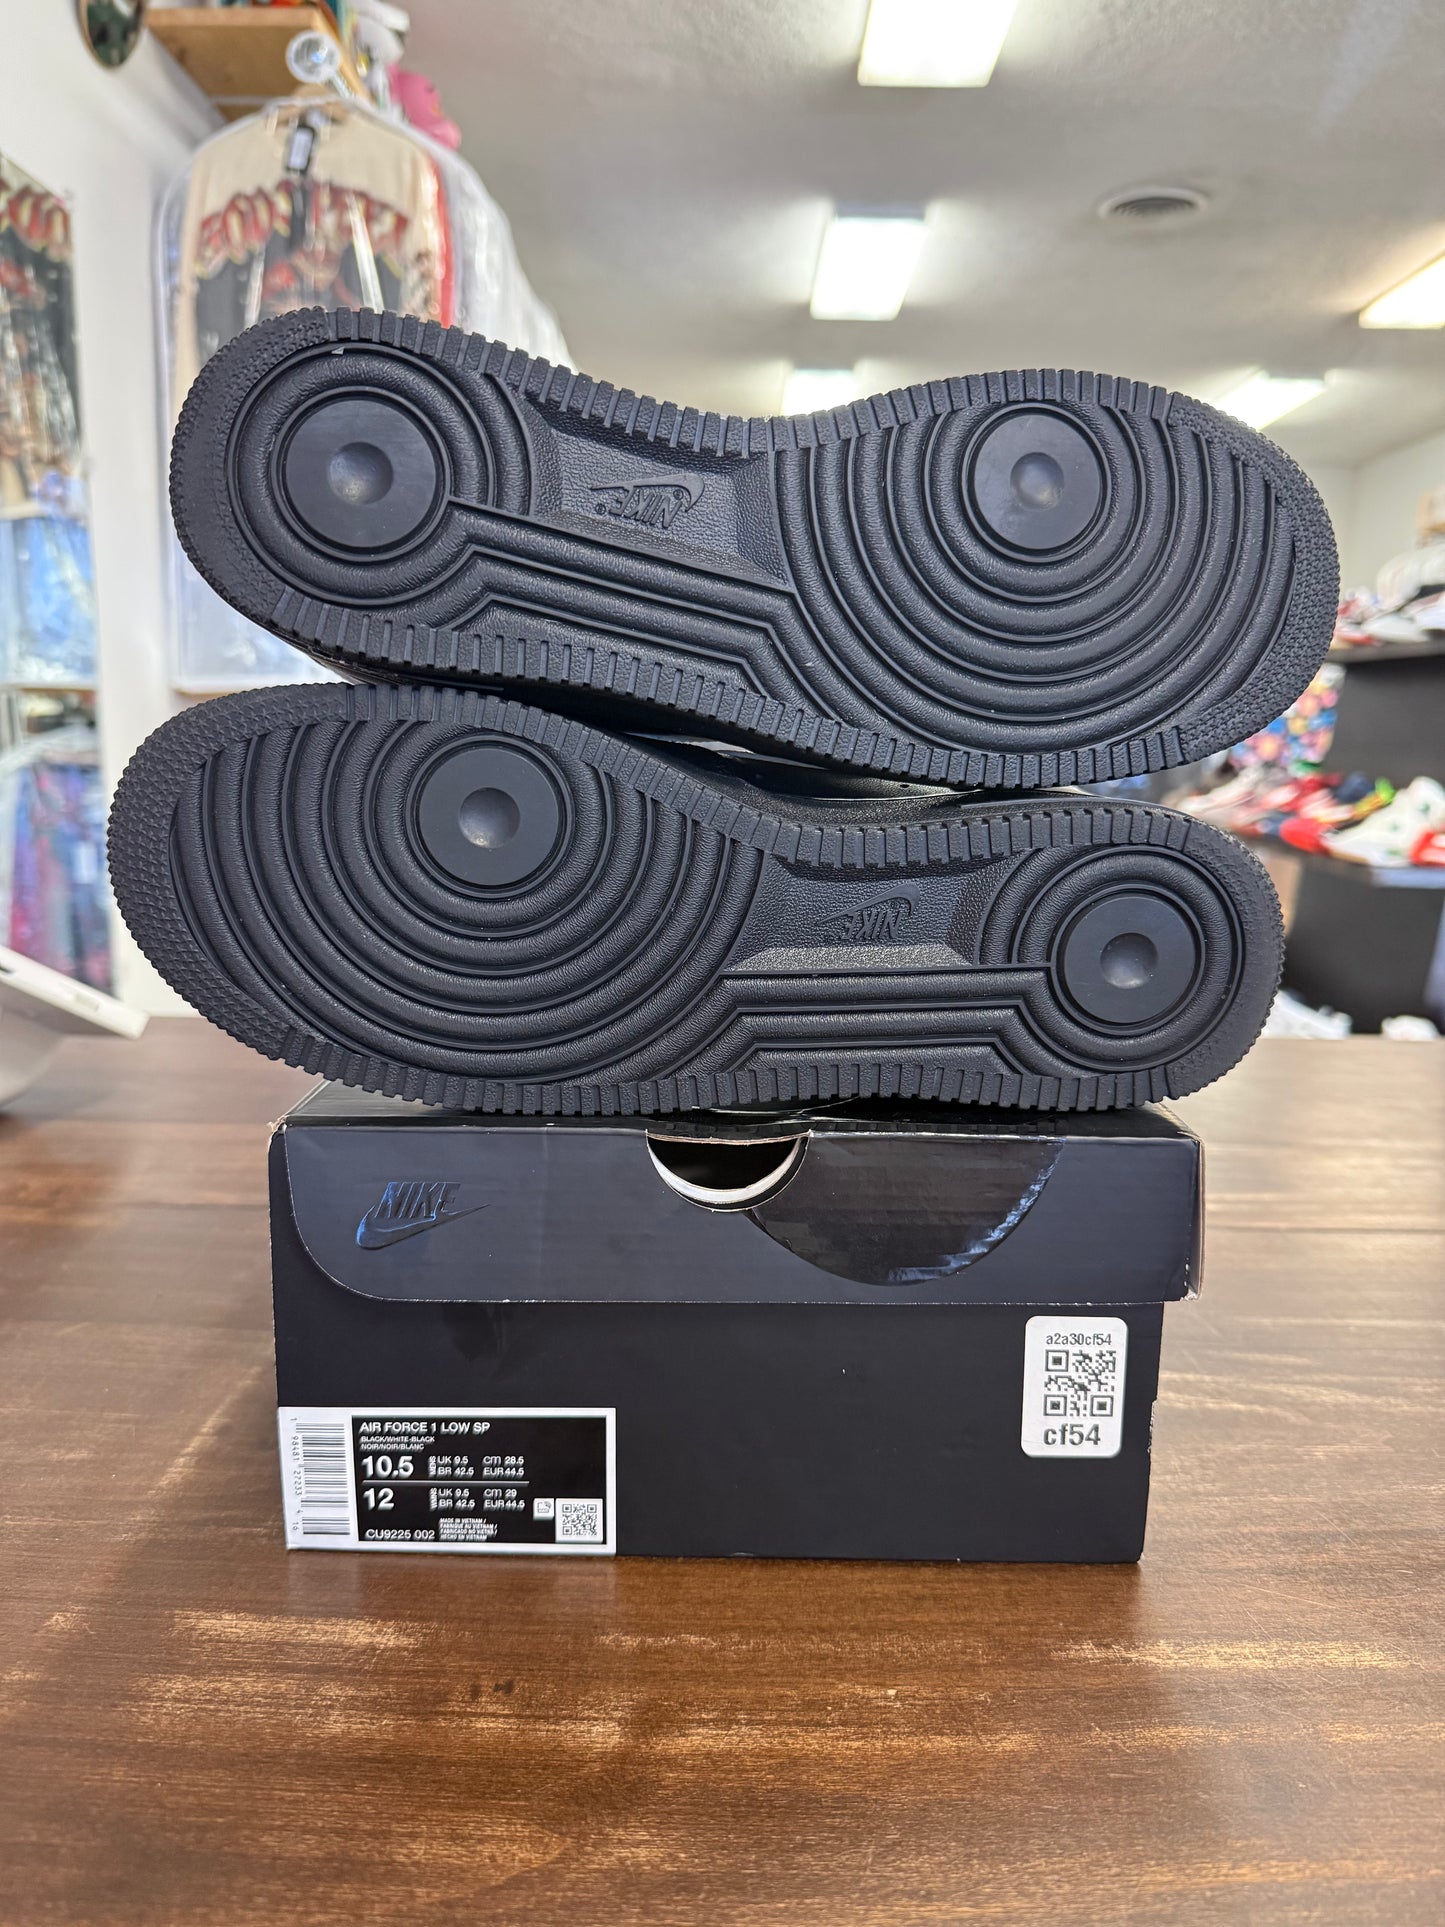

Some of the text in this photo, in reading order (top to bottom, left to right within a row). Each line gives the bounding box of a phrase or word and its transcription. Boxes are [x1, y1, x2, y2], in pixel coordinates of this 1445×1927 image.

[609, 485, 683, 528] NIKE
[841, 910, 902, 940] NIKE
[374, 1181, 461, 1218] NIKE
[1046, 1332, 1112, 1345] a2a30cf54
[359, 1421, 490, 1435] AIR FORCE 1 LOW SP
[360, 1435, 435, 1443] BLACK/WHITE-BLACK
[1043, 1423, 1101, 1446] cf54
[291, 1435, 301, 1461] 98481
[360, 1443, 425, 1451] NOIR/NOIR/BLANC
[361, 1455, 414, 1478] 10.5
[428, 1456, 437, 1476] MENS
[437, 1456, 469, 1465] UK 9.5
[504, 1456, 525, 1465] 28.5
[438, 1467, 475, 1476] BR 42.5
[483, 1467, 525, 1476] EUR 44.5
[293, 1470, 303, 1496] 27233
[363, 1487, 395, 1510] 12
[438, 1488, 469, 1497] UK 9.5
[505, 1488, 517, 1497] 29
[439, 1499, 475, 1508] BR 42.5
[484, 1499, 525, 1508] EUR 44.5
[364, 1528, 436, 1540] CU9225 002
